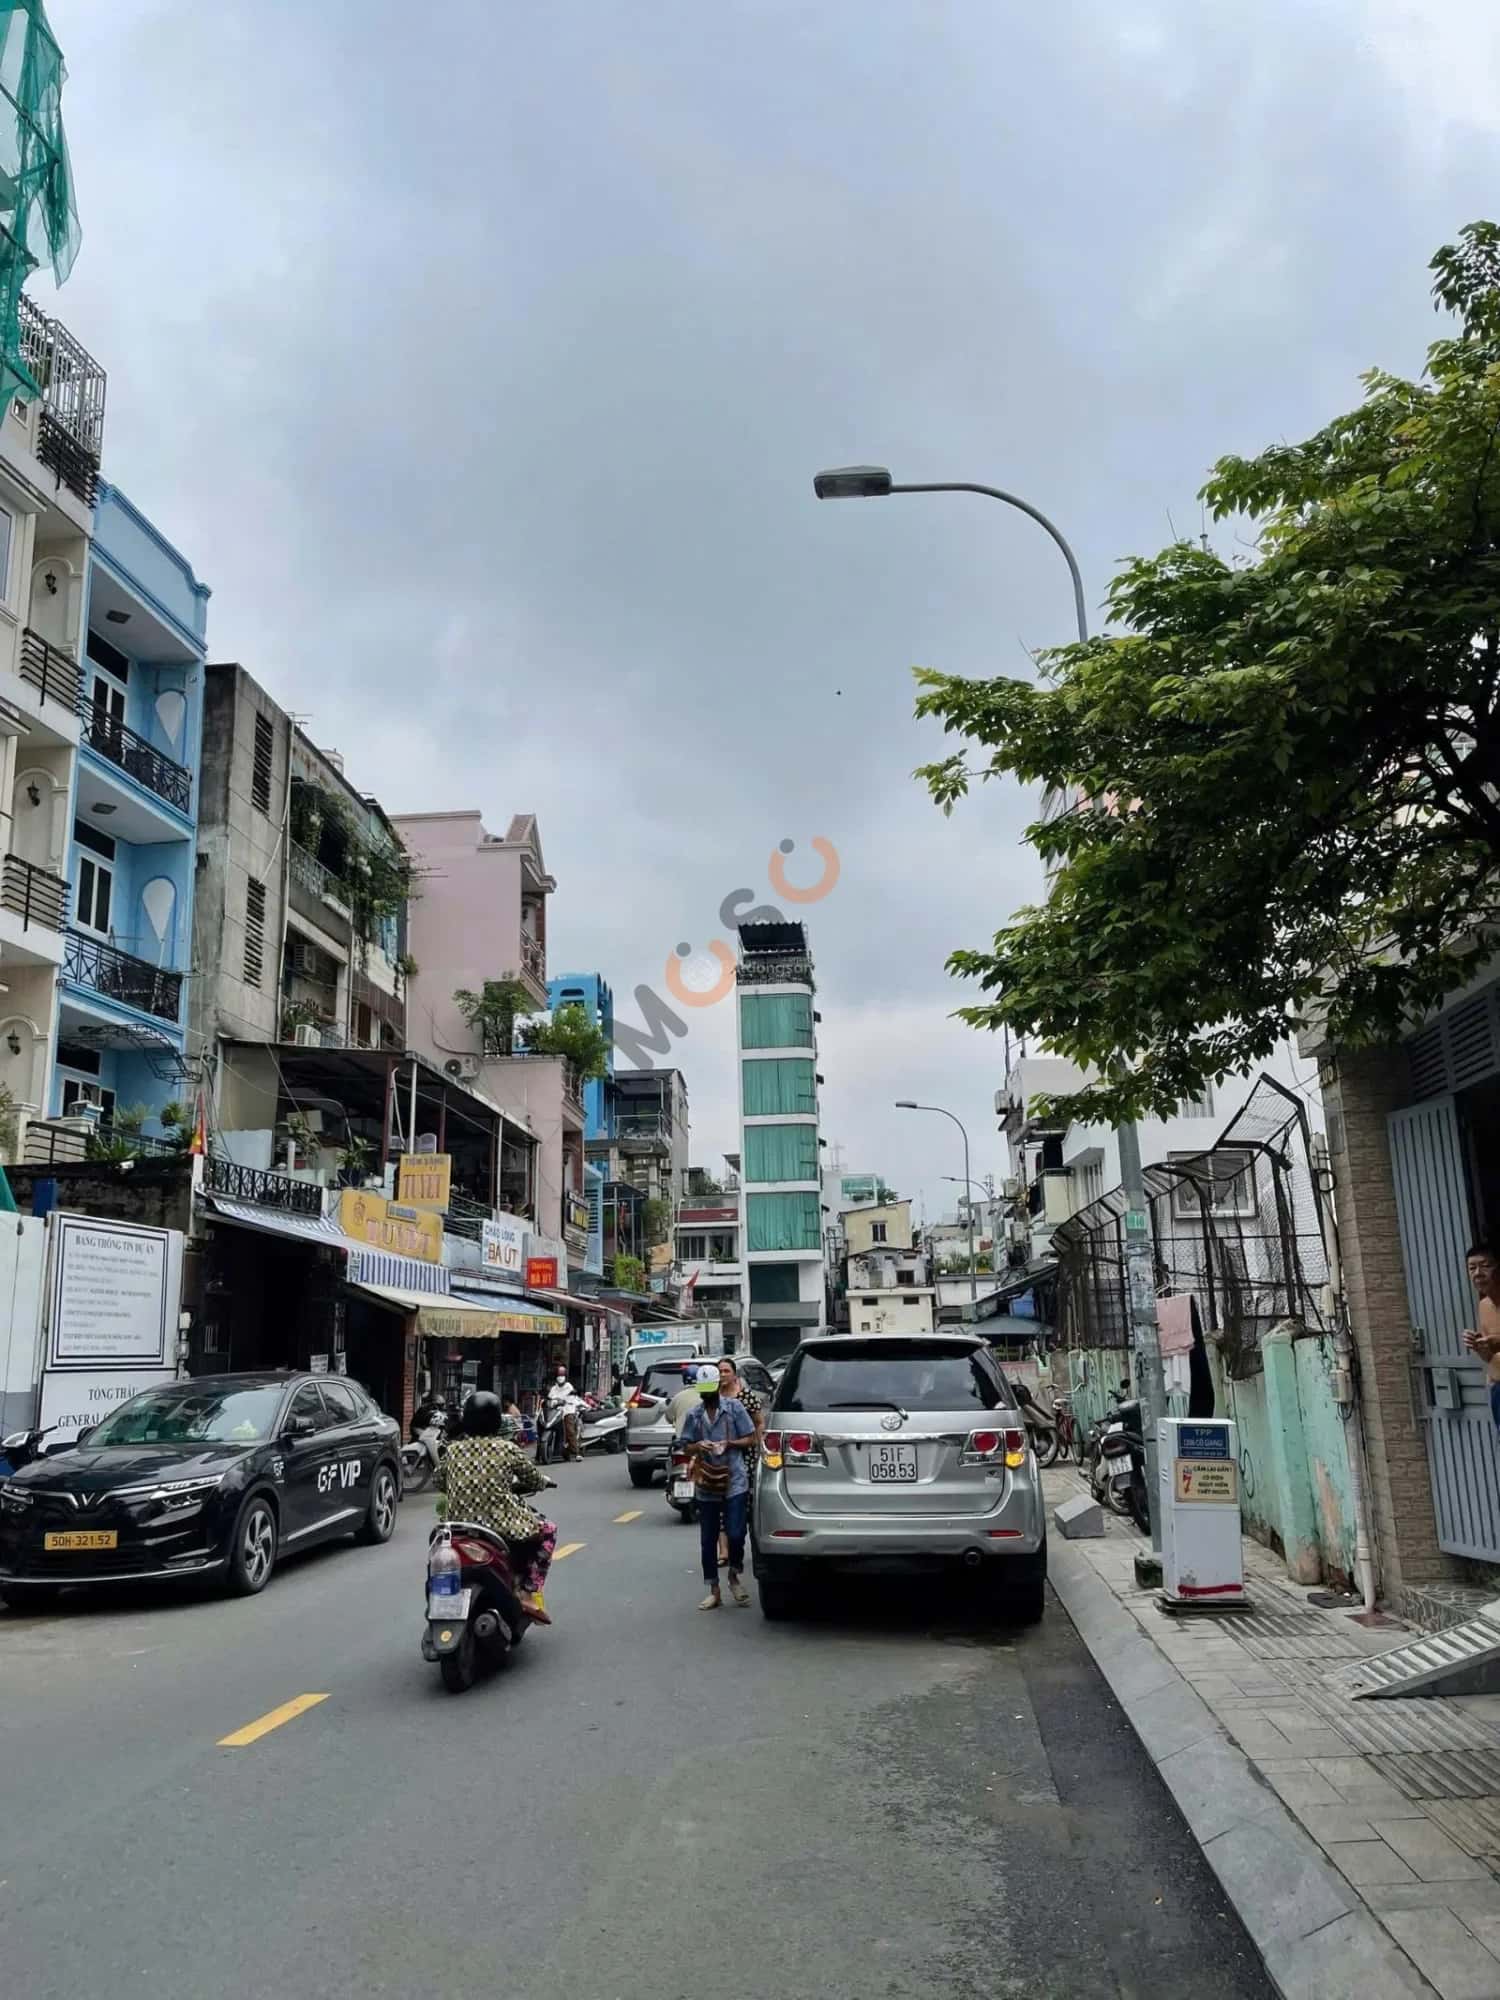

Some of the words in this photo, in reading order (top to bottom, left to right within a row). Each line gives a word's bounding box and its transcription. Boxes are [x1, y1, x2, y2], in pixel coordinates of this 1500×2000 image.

[57, 1412, 100, 1428] GENERAL
[880, 1447, 905, 1462] 51F
[339, 1459, 361, 1489] VIP
[871, 1463, 916, 1479] 058.53
